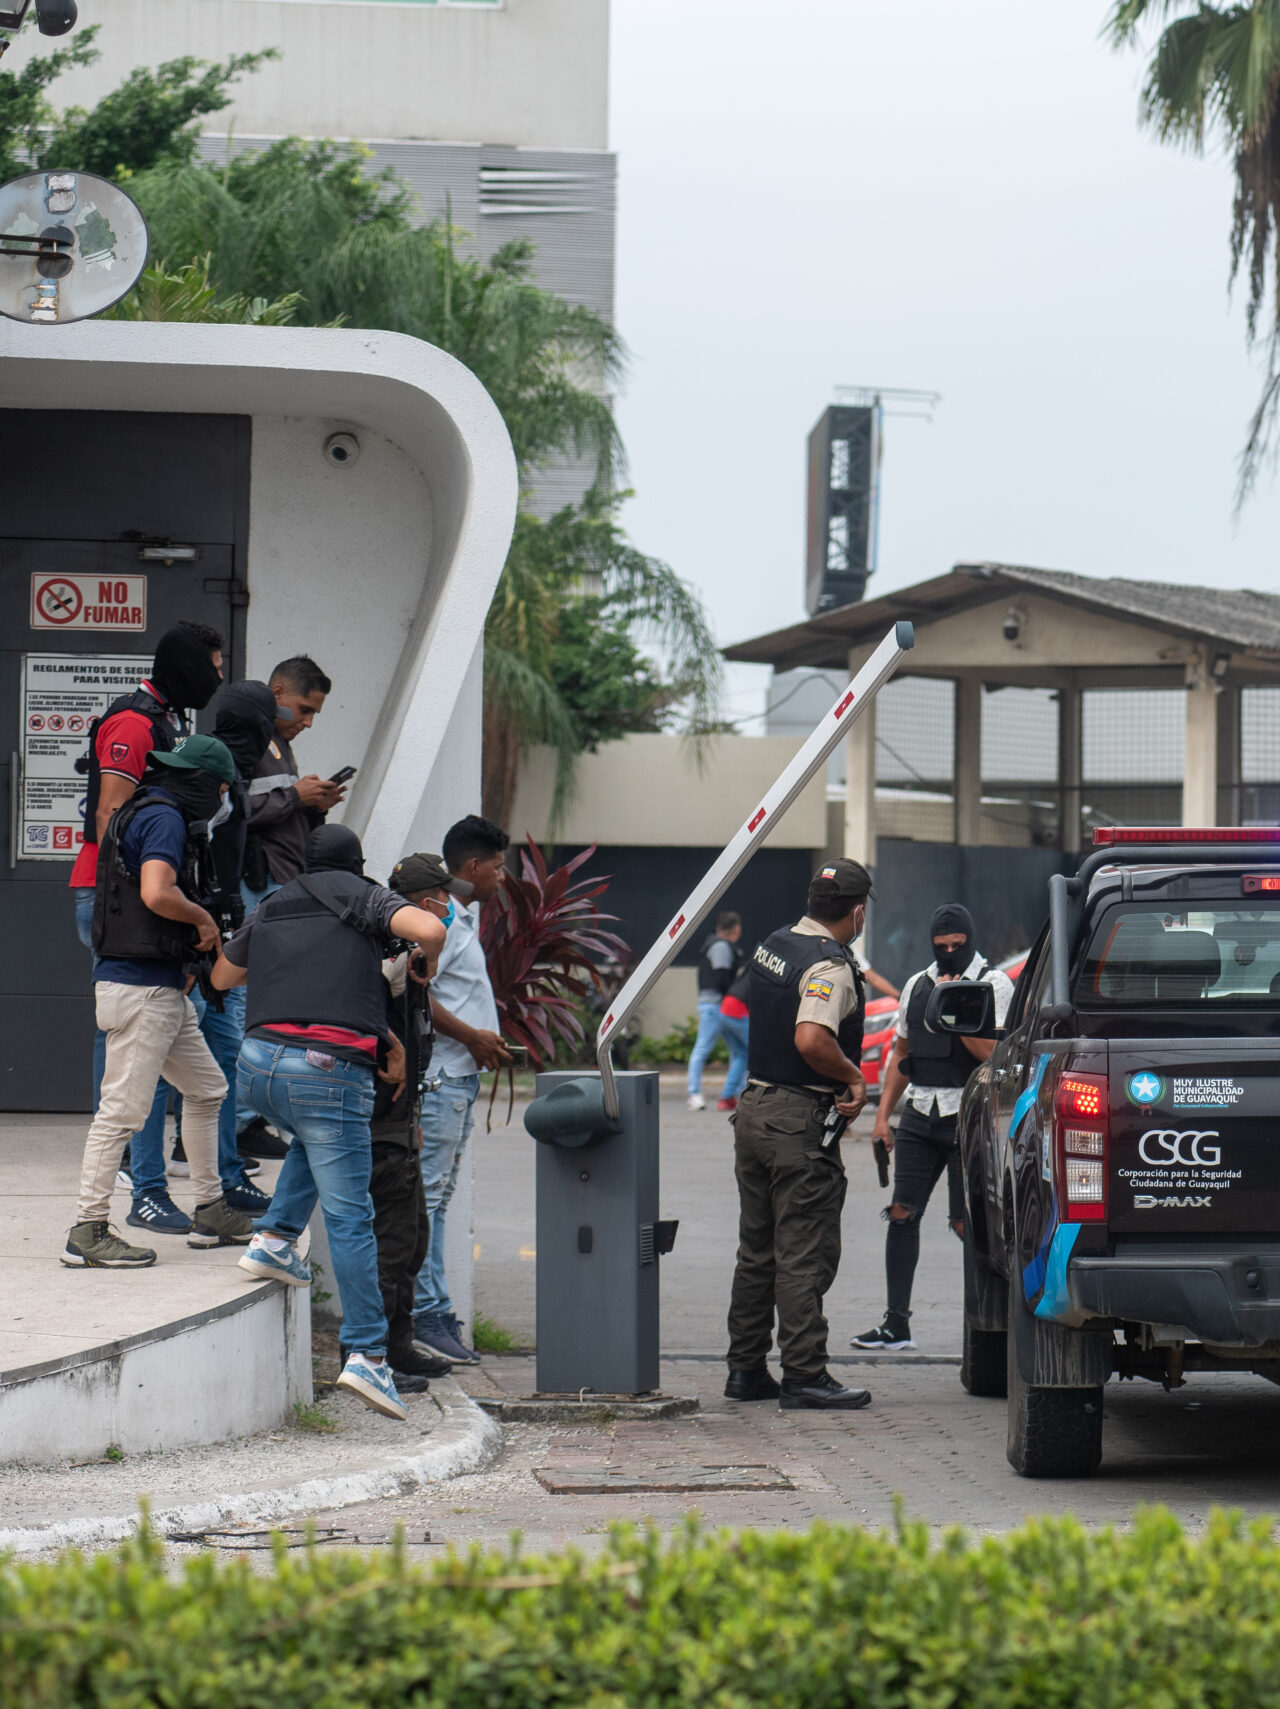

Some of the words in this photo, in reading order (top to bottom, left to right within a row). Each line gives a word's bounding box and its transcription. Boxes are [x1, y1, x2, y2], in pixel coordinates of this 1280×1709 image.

[98, 581, 128, 604] NO
[83, 605, 142, 624] FUMAR
[33, 664, 107, 674] REGLAMENTOS
[109, 666, 122, 674] DE
[124, 666, 152, 675] SEGU
[73, 675, 100, 684] PARA
[102, 676, 143, 685] VISITAS
[754, 945, 787, 977] POLICIA
[1173, 1078, 1193, 1087] MUY
[1196, 1078, 1233, 1087] ILUSTRE
[1173, 1086, 1244, 1095] MUNICIPALIDAD
[1173, 1094, 1185, 1103] DE
[1187, 1094, 1238, 1104] GUAYAQUIL
[1138, 1129, 1221, 1166] CSCG
[1118, 1168, 1168, 1179] Corporación
[1171, 1171, 1189, 1179] para
[1191, 1169, 1199, 1178] la
[1201, 1169, 1242, 1180] Seguridad
[1129, 1179, 1173, 1188] Ciudadana
[1175, 1179, 1186, 1188] de
[1188, 1180, 1230, 1190] Guayaquil
[1133, 1194, 1213, 1209] D-MAX
